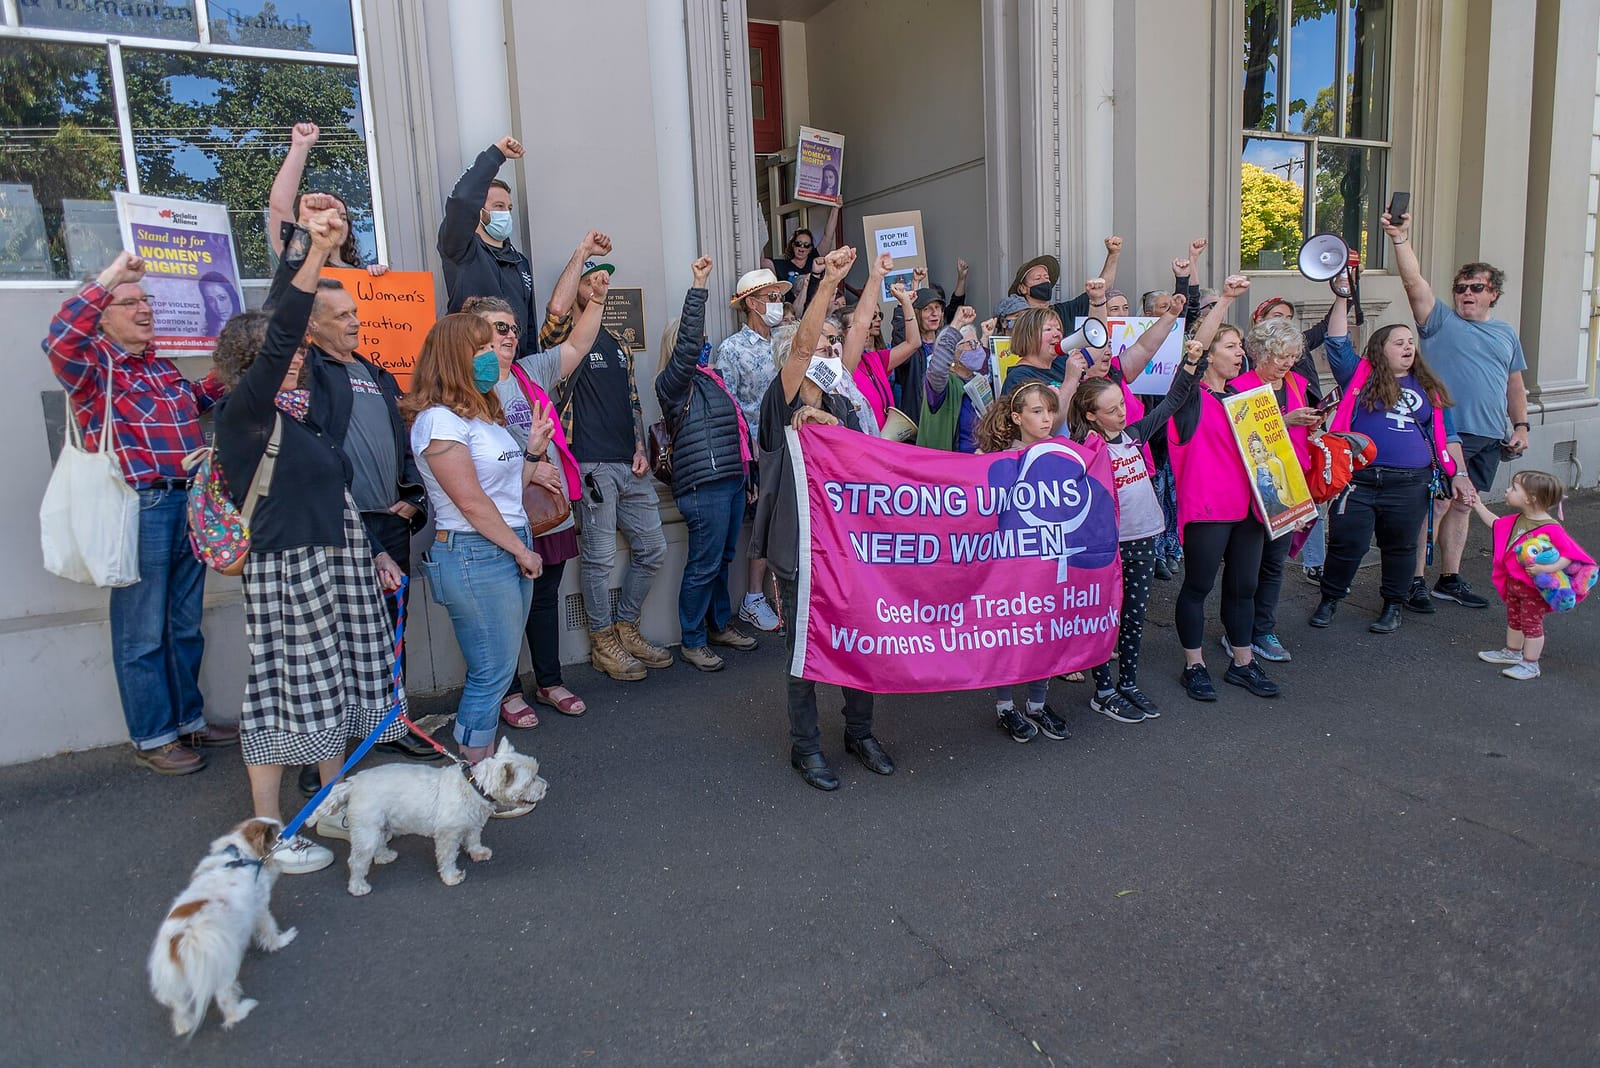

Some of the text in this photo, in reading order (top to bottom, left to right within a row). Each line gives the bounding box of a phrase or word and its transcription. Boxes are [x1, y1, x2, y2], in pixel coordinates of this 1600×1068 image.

[137, 228, 206, 249] Stand up for
[880, 231, 909, 241] STOP THE
[883, 240, 908, 248] BLOKES
[137, 244, 213, 276] WOMEN'S RIGHTS
[357, 281, 425, 303] Women's
[153, 308, 177, 316] gainst
[359, 315, 412, 332] eration
[362, 334, 380, 345] to
[1254, 395, 1271, 409] OUR
[1253, 404, 1279, 422] BODIES
[1263, 418, 1280, 432] OUR
[1127, 466, 1136, 475] is
[823, 480, 968, 517] STRONG
[848, 523, 1064, 565] NEED WOMEN
[875, 583, 1101, 628] Geelong Trades Hall
[830, 605, 1120, 656] Womens Unionist Netwok
